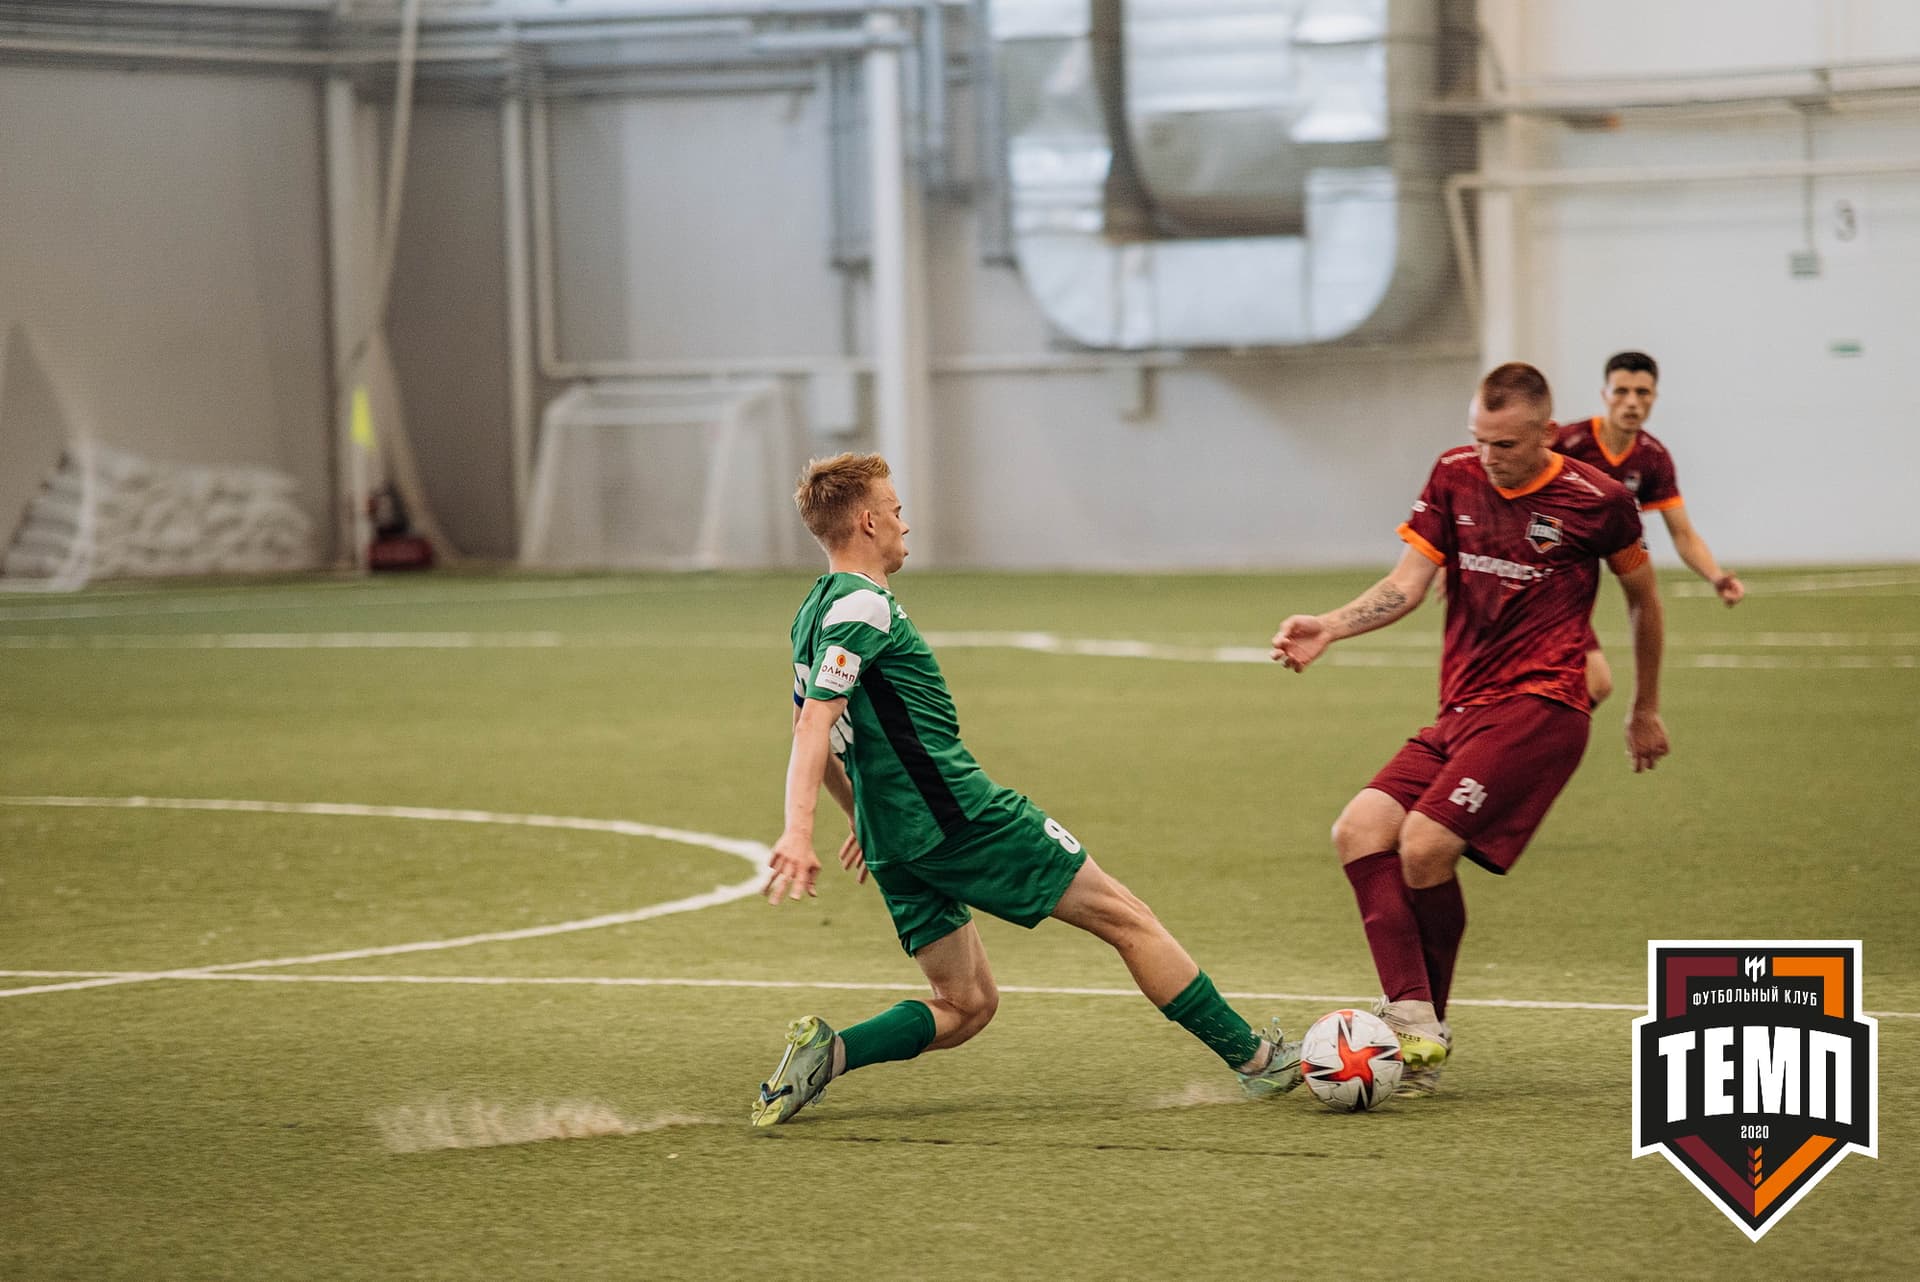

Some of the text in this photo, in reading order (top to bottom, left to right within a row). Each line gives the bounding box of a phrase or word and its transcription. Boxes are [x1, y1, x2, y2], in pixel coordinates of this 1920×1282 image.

[821, 664, 856, 683] ОЛИМП
[1447, 777, 1489, 814] 24
[1043, 817, 1082, 855] 8
